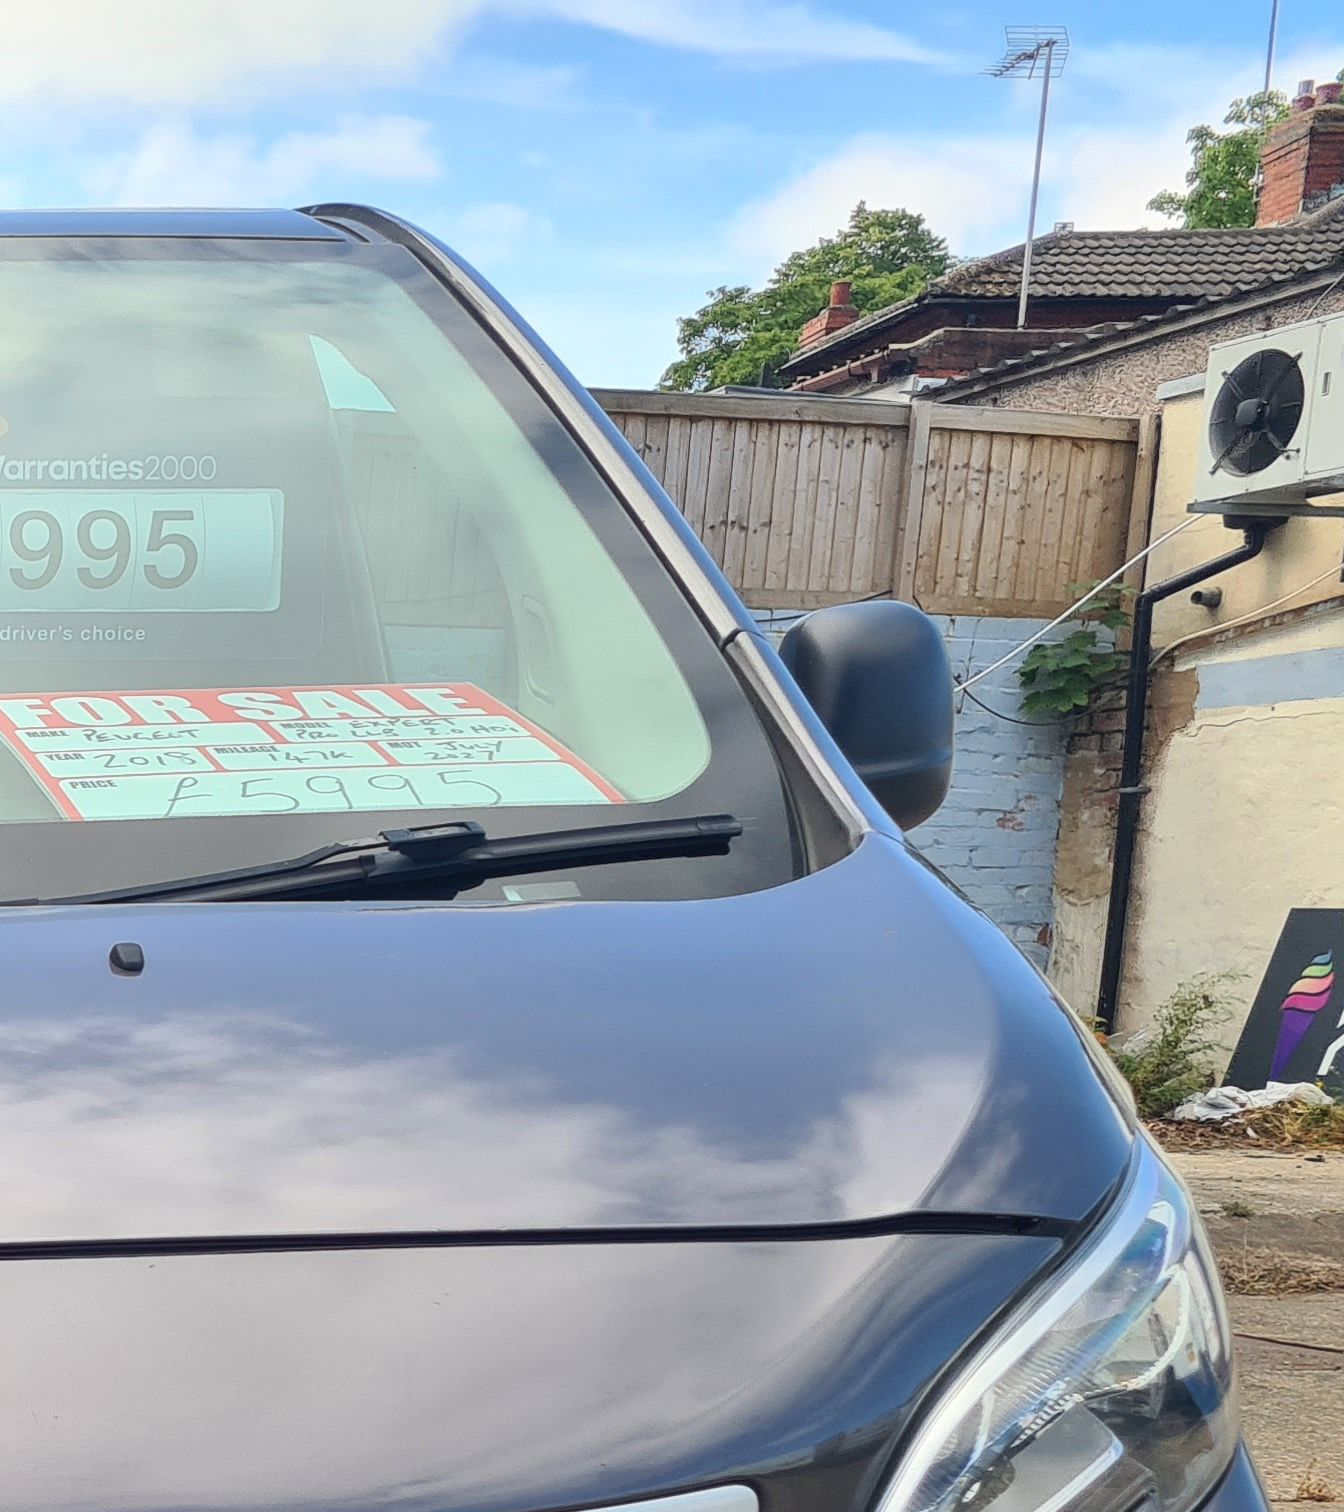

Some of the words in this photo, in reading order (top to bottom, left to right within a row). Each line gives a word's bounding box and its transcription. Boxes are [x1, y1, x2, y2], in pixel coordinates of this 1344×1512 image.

[0, 626, 73, 641] driver's
[80, 626, 146, 641] choice
[216, 688, 489, 721] SALE
[279, 721, 333, 730] MODEL
[348, 717, 458, 729] EXPERT
[26, 730, 69, 738] MAKE
[427, 727, 465, 737] 2.0
[213, 745, 281, 755] MILEAGE
[387, 741, 423, 749] MOT
[435, 739, 504, 753] JULY
[45, 752, 85, 761] YEAR
[93, 751, 197, 769] 2018
[424, 750, 496, 761] 2027
[68, 779, 119, 790] PRICE
